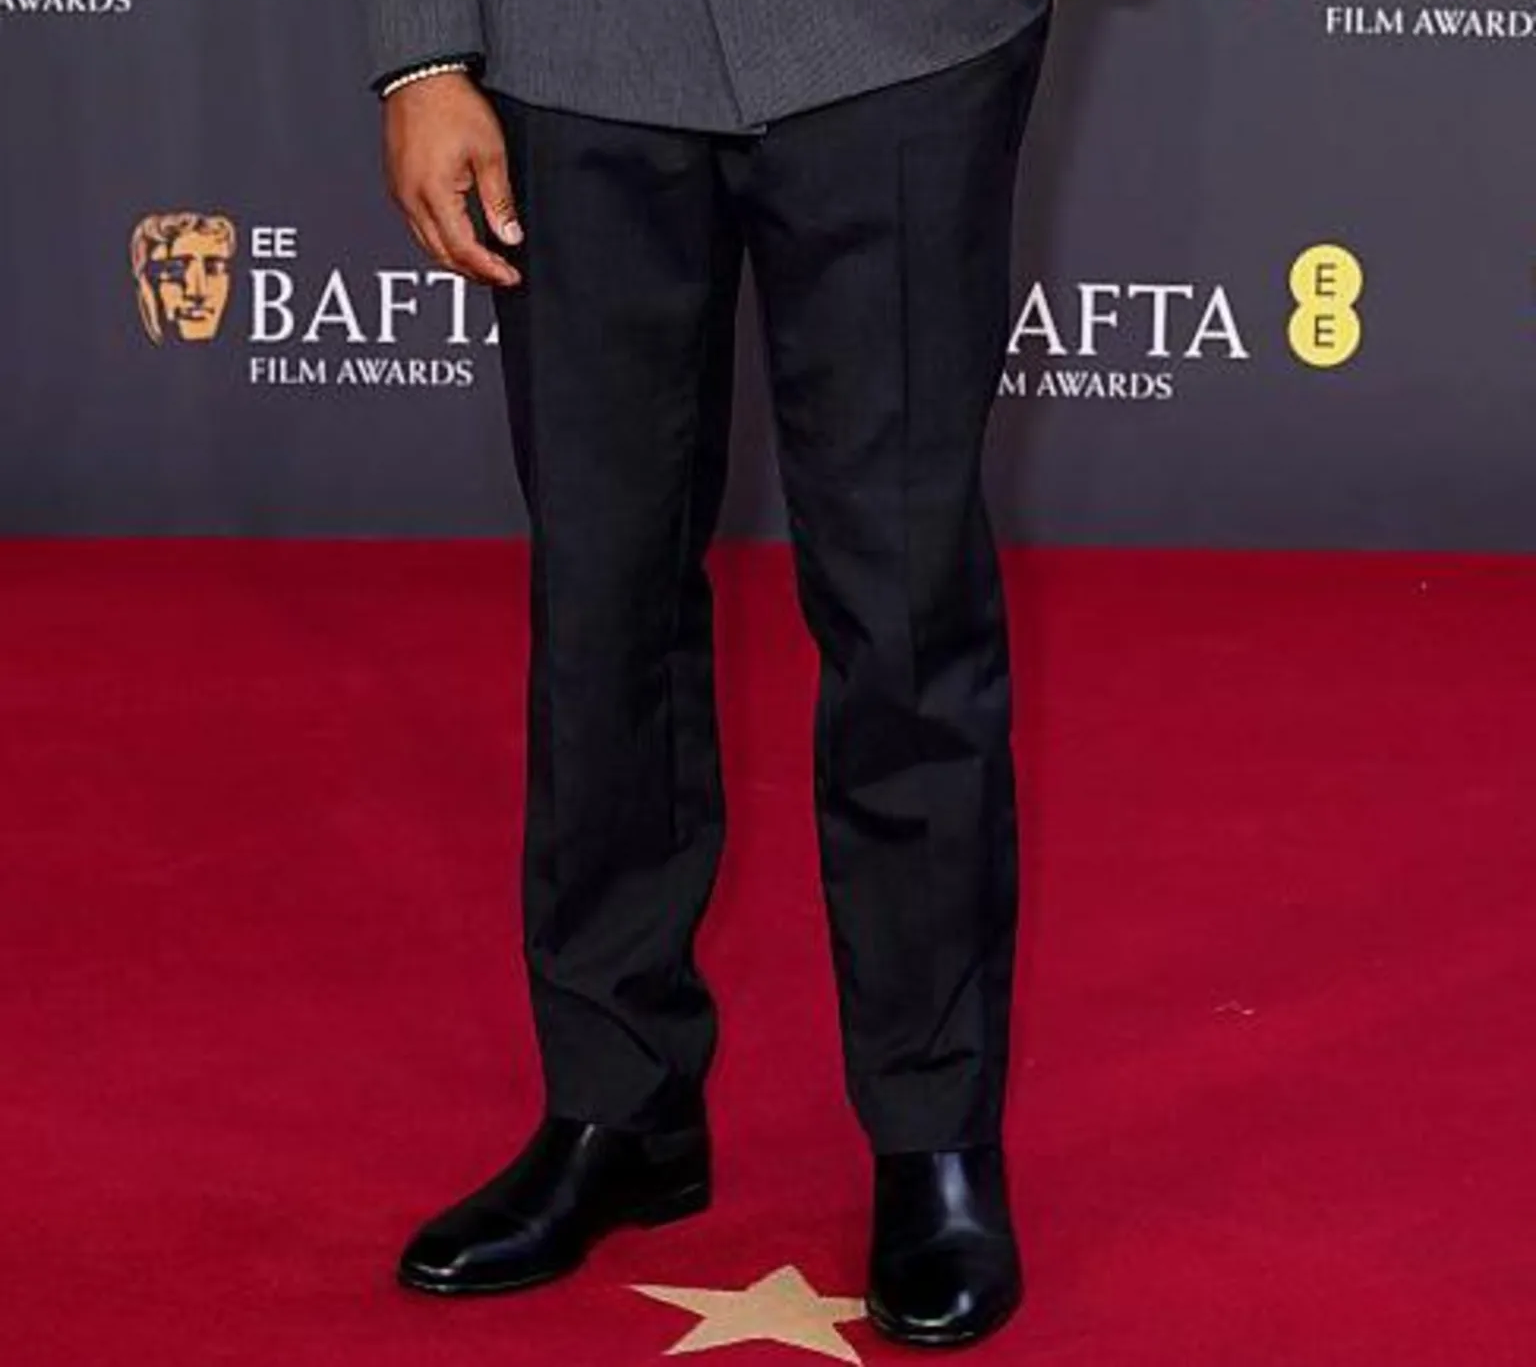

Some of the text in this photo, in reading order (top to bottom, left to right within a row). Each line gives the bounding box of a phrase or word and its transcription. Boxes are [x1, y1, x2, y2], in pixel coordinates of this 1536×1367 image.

[1326, 7, 1536, 37] FILM AWARD
[251, 227, 297, 258] EE
[251, 269, 499, 344] BAFT
[251, 357, 473, 385] FILM AWARDS
[1037, 371, 1172, 399] AWARDS
